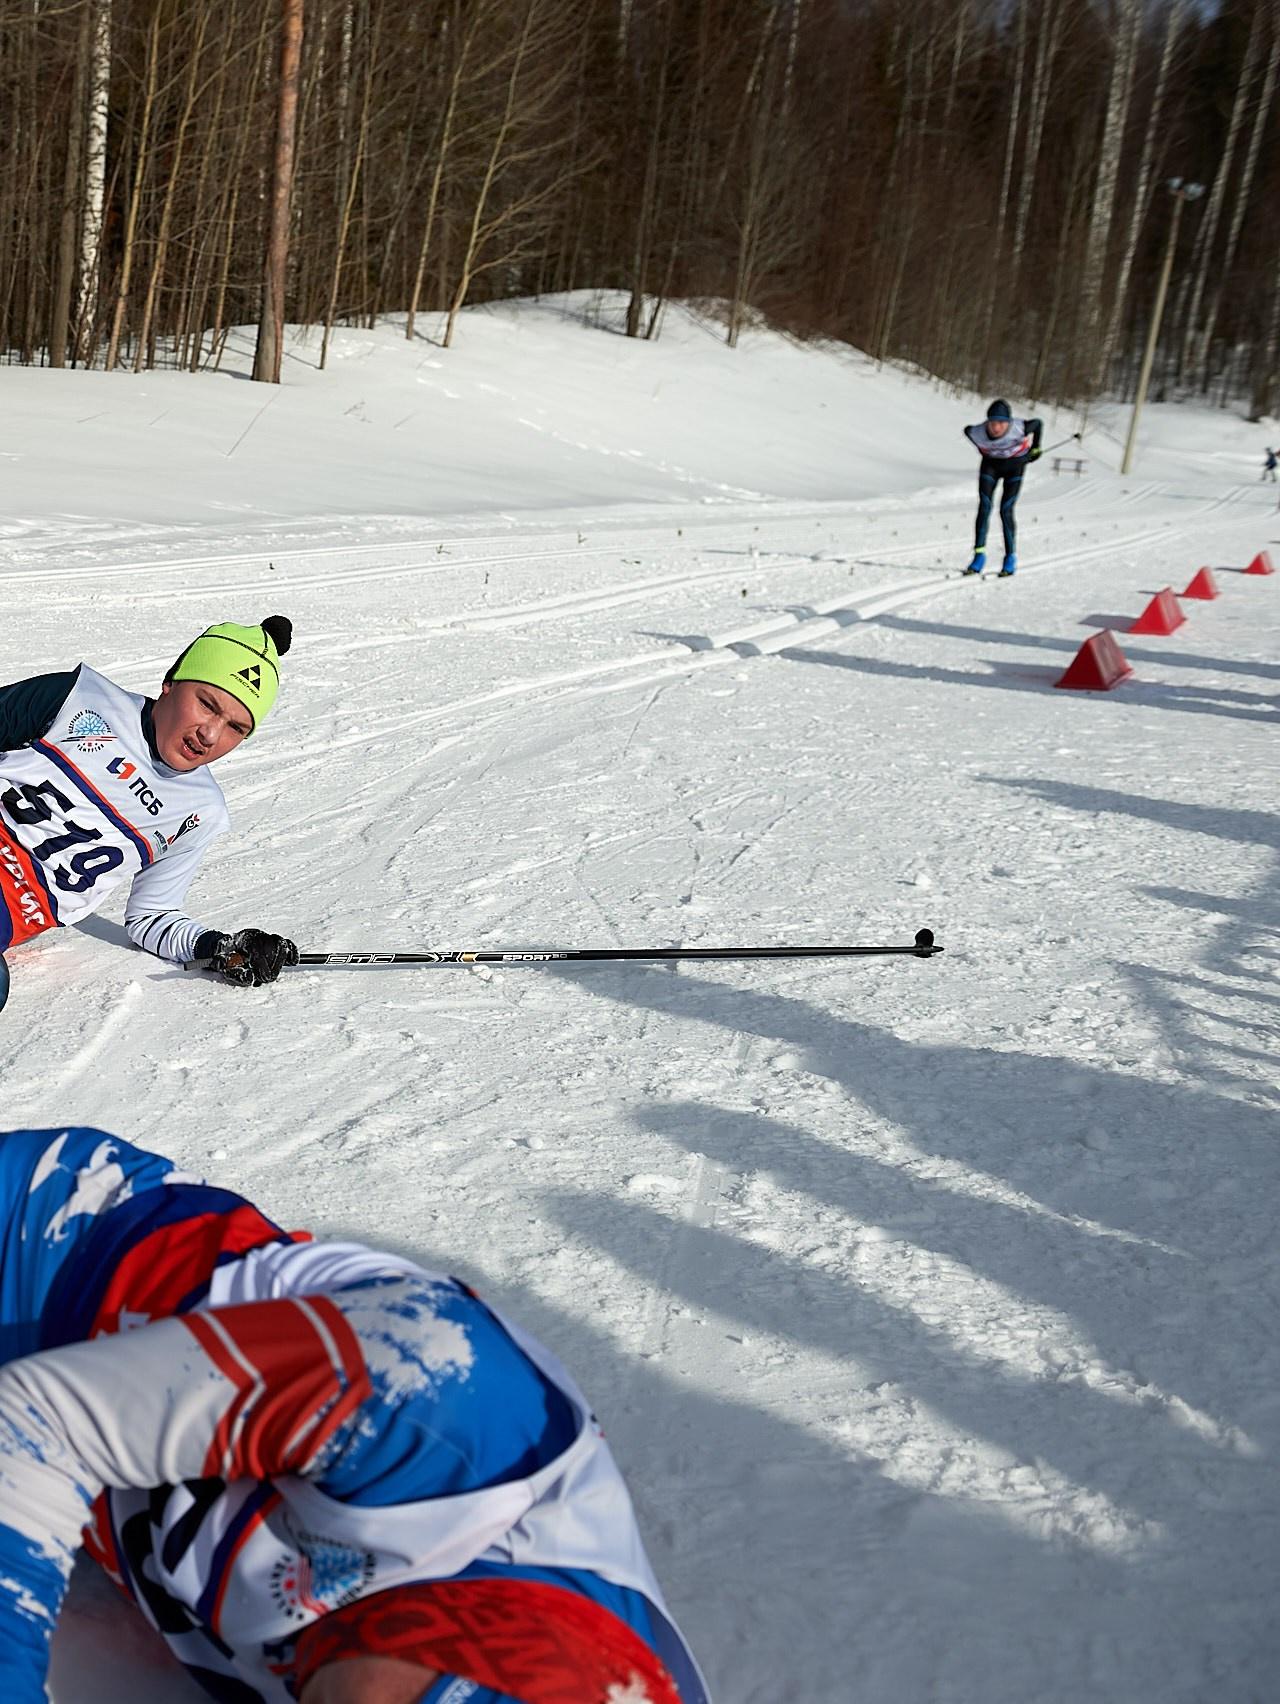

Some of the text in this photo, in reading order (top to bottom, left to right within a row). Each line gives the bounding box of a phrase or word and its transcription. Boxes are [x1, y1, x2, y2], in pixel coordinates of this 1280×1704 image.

[128, 776, 164, 816] ПСБ
[0, 780, 125, 893] 519
[324, 952, 397, 965] STC
[502, 953, 552, 963] SPORT
